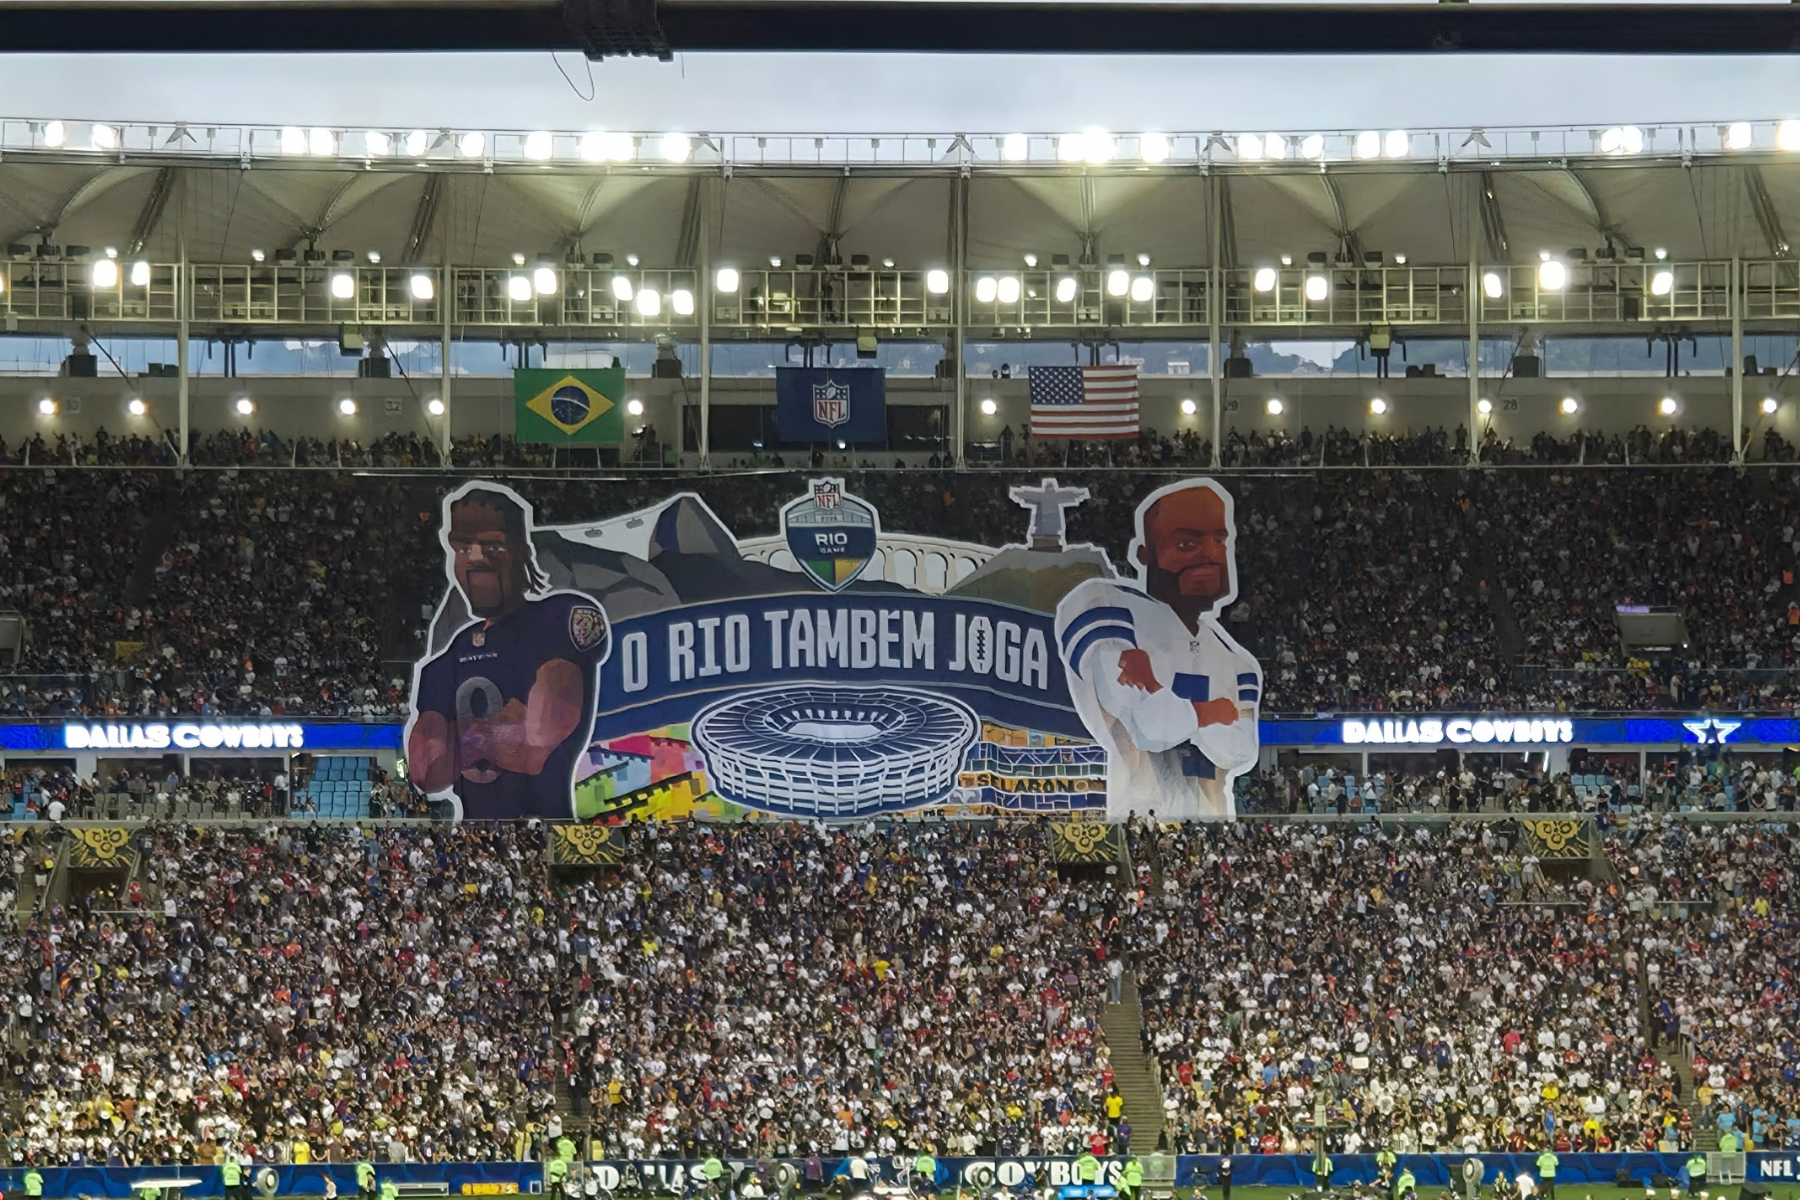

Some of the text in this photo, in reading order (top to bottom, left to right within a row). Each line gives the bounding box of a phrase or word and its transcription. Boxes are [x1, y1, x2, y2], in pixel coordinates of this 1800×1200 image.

[386, 400, 400, 411] 32
[818, 401, 846, 421] NFL
[1224, 400, 1238, 411] 29
[1504, 399, 1517, 411] 28
[816, 494, 839, 509] NFL
[815, 533, 847, 546] RIO
[622, 631, 648, 693] O
[668, 614, 750, 682] RIO
[949, 613, 1048, 690] JOGA
[65, 724, 303, 748] DALLAS COWBOYS
[1343, 720, 1573, 743] DALLAS COWBOYS
[1761, 1160, 1793, 1177] NFL
